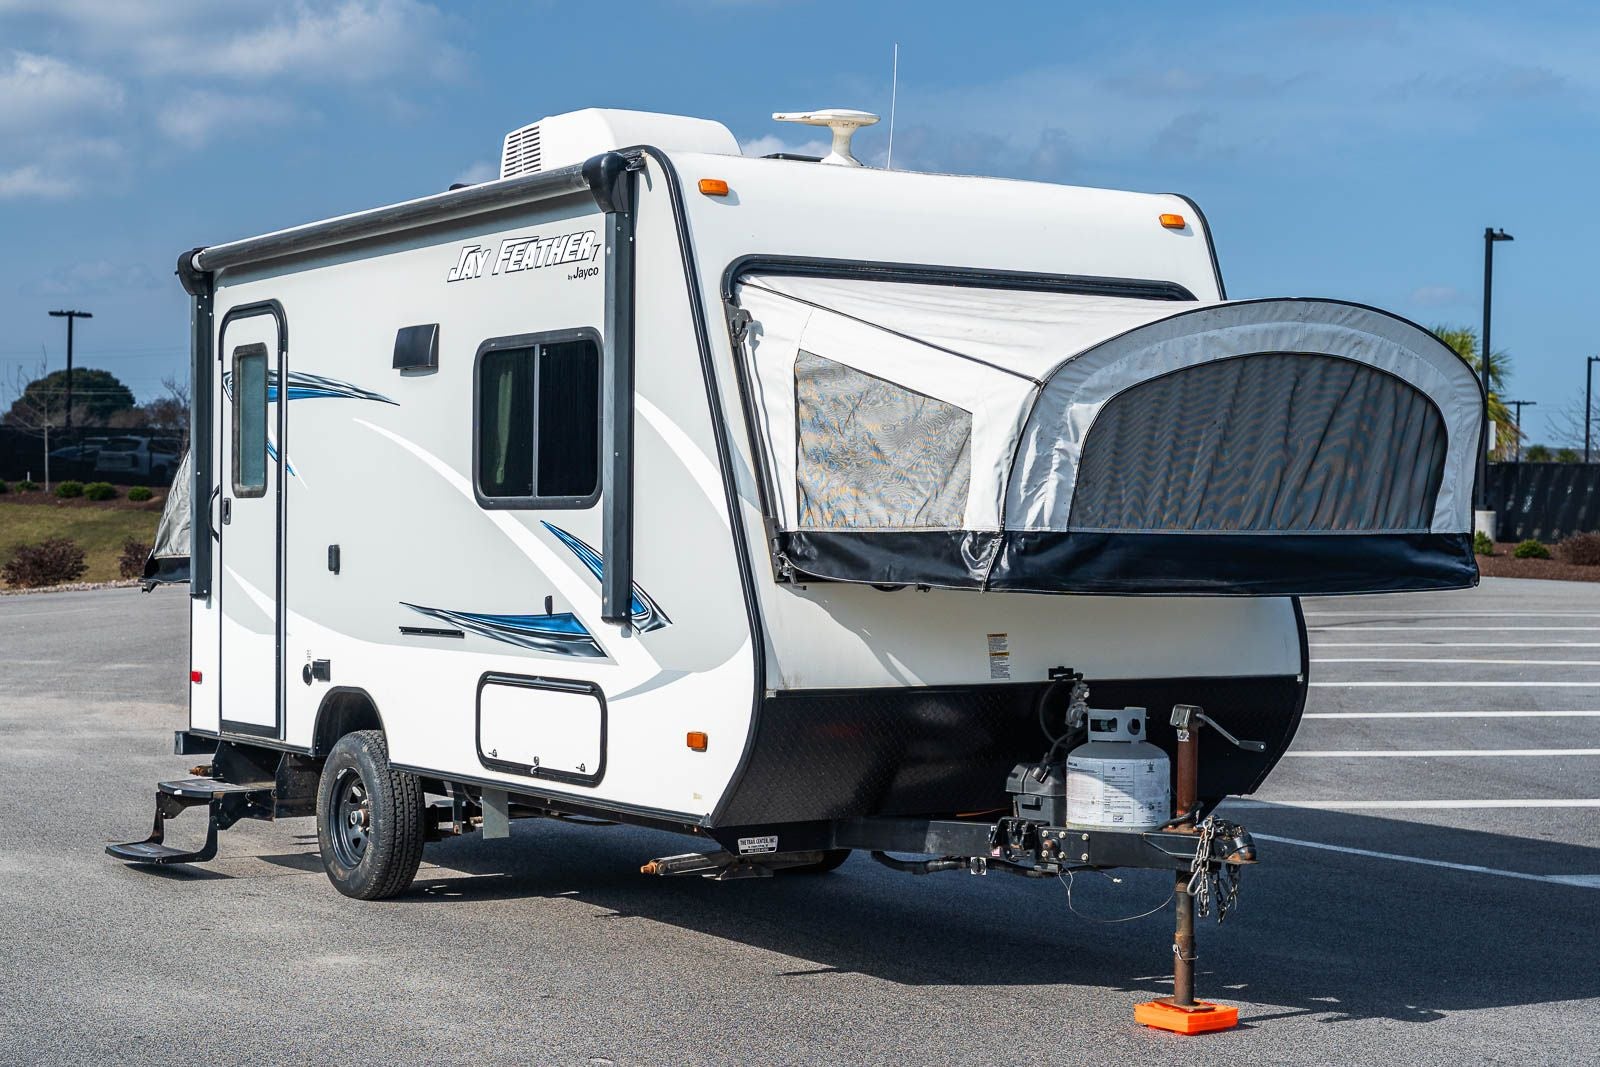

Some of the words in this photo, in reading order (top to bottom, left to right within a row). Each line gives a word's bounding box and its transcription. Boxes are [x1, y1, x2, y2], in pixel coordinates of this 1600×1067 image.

[447, 245, 491, 282] JAY
[492, 230, 596, 275] FEATHER
[573, 266, 599, 280] Jayco
